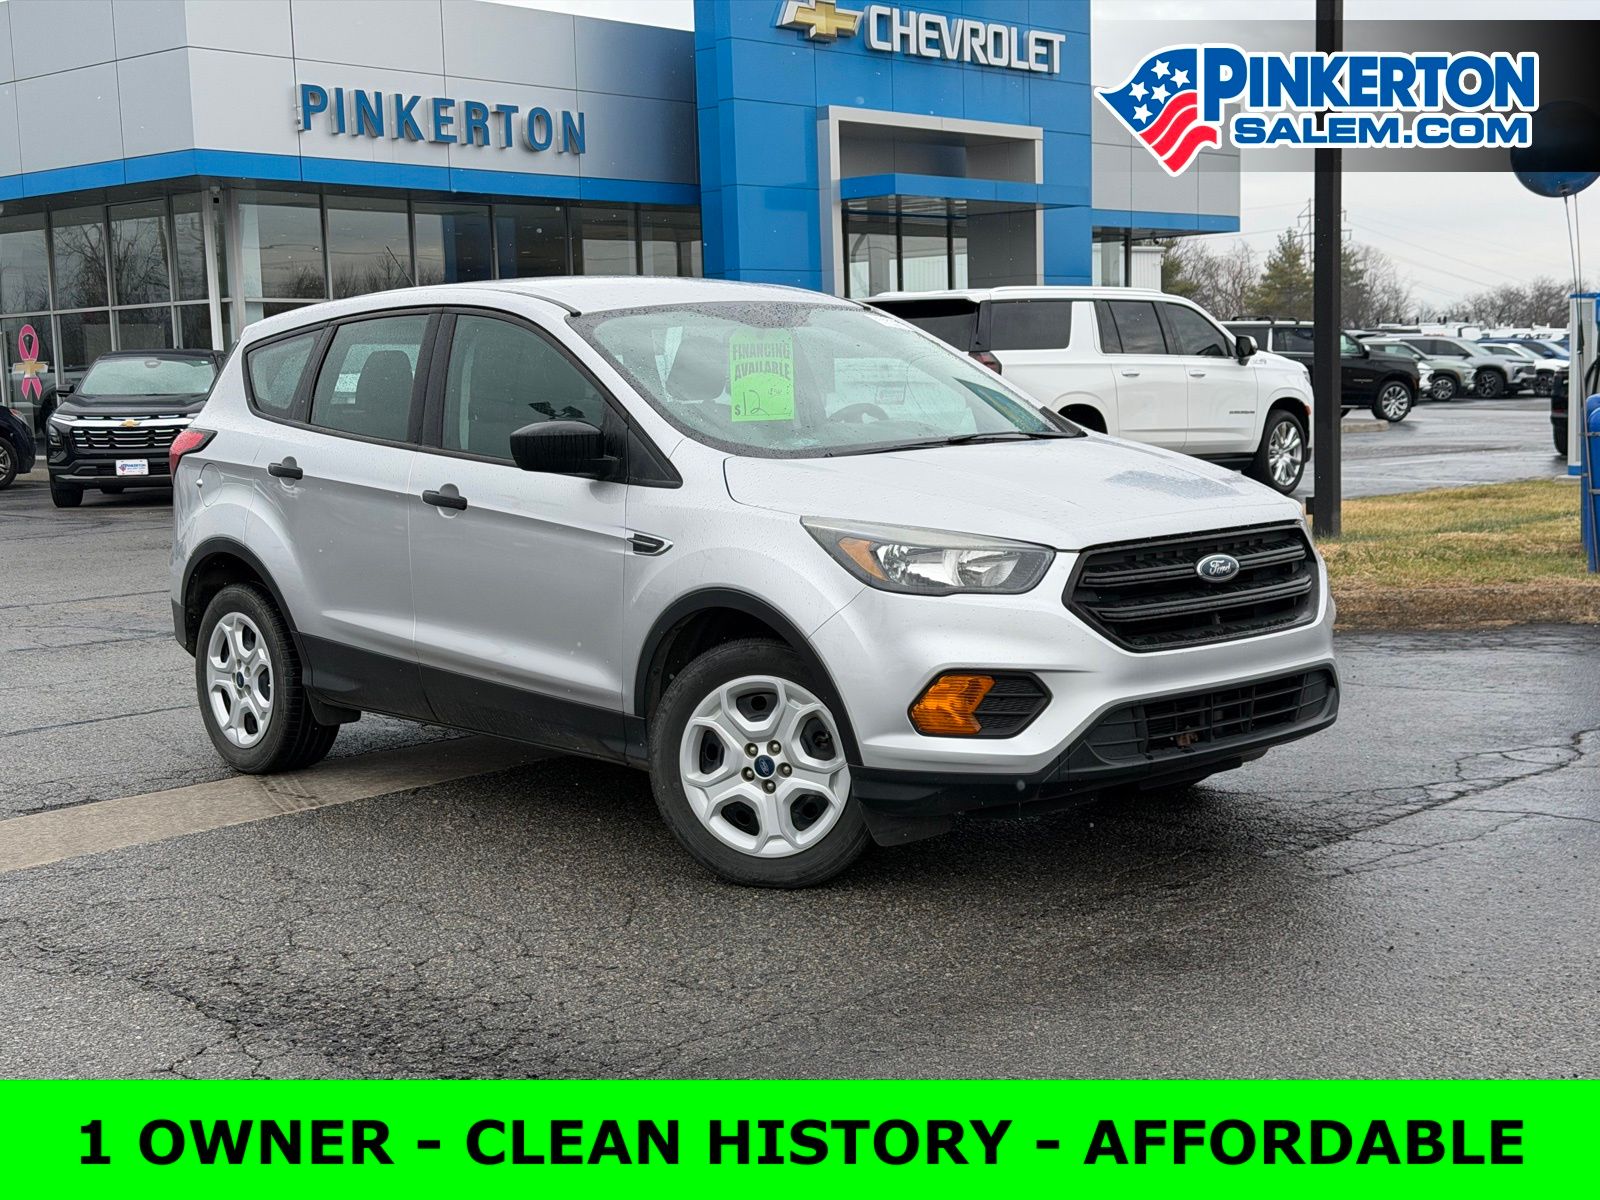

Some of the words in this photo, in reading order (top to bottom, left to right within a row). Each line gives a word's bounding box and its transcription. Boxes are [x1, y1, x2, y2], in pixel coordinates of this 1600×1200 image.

[864, 4, 1066, 74] CHEVROLET
[297, 83, 586, 154] PINKERTON
[732, 342, 791, 361] FINANCING
[734, 360, 791, 381] AVAILABLE
[1209, 559, 1231, 575] Ford
